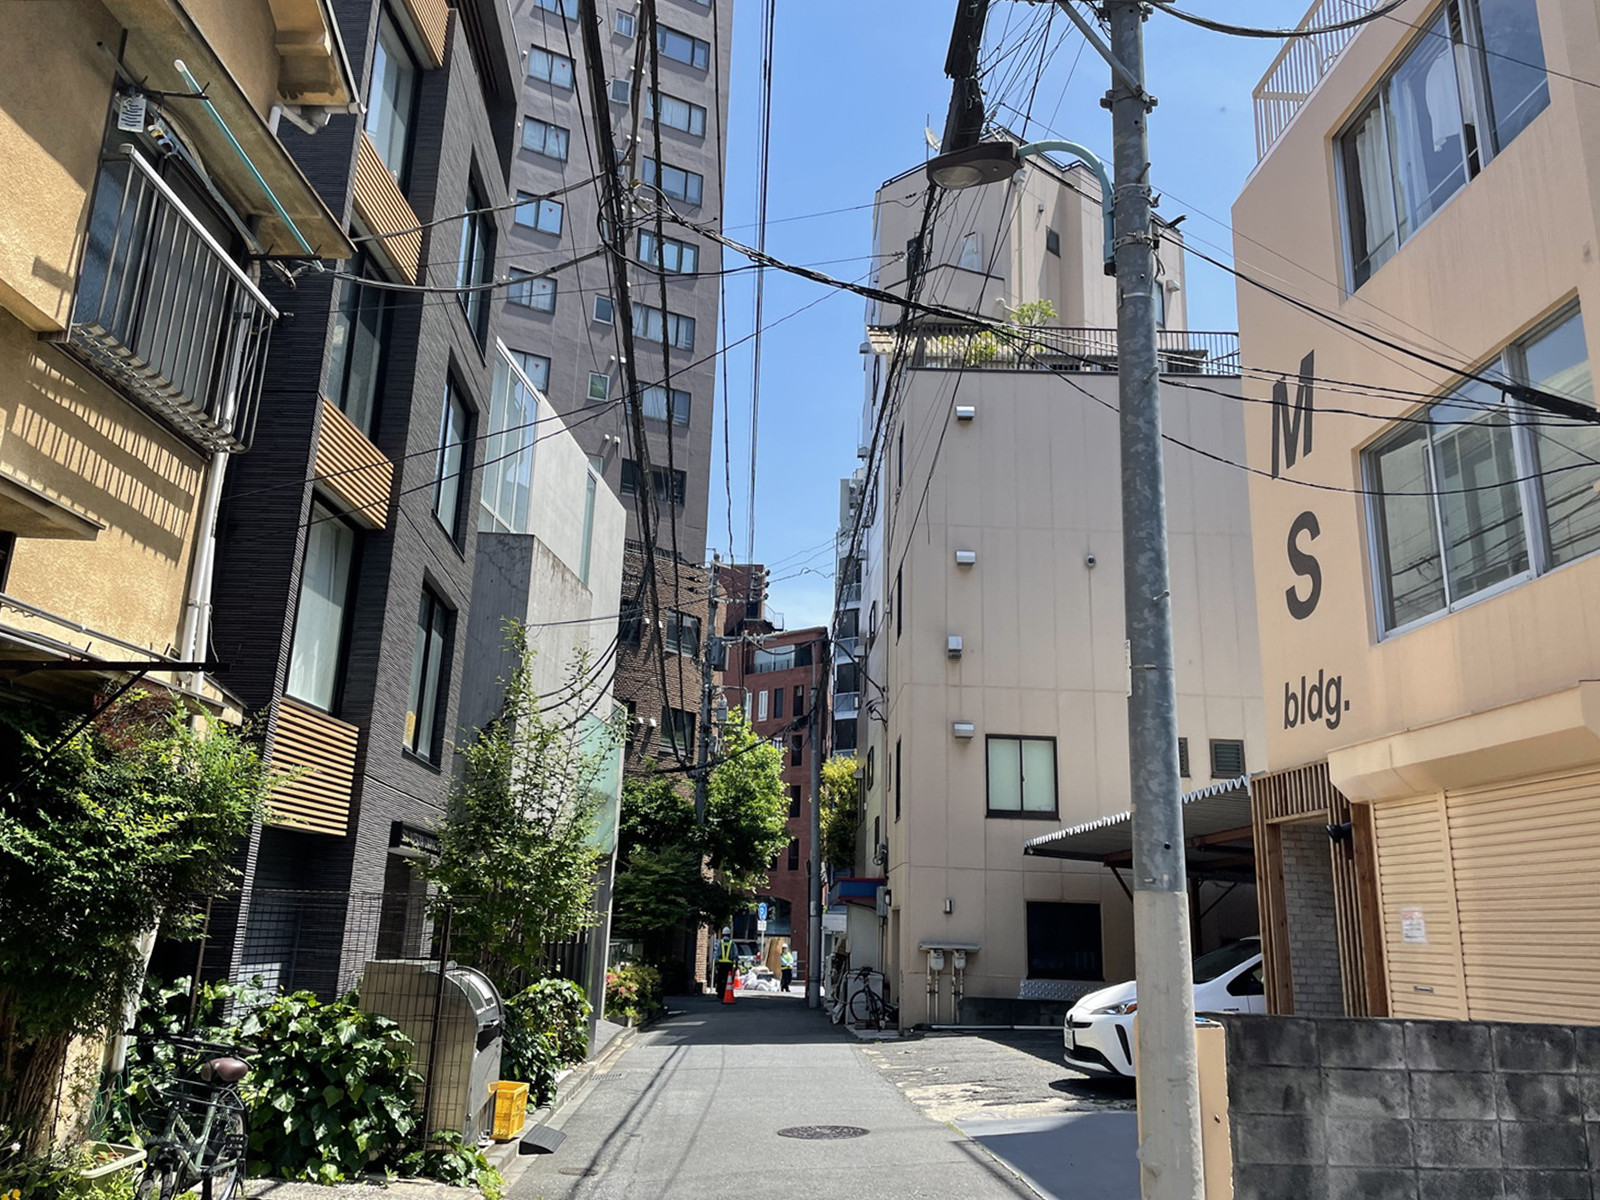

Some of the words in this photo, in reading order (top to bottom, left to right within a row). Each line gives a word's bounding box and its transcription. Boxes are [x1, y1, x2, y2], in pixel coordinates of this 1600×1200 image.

[1272, 350, 1314, 480] M
[1285, 510, 1322, 620] S
[1284, 668, 1350, 730] bldg.
